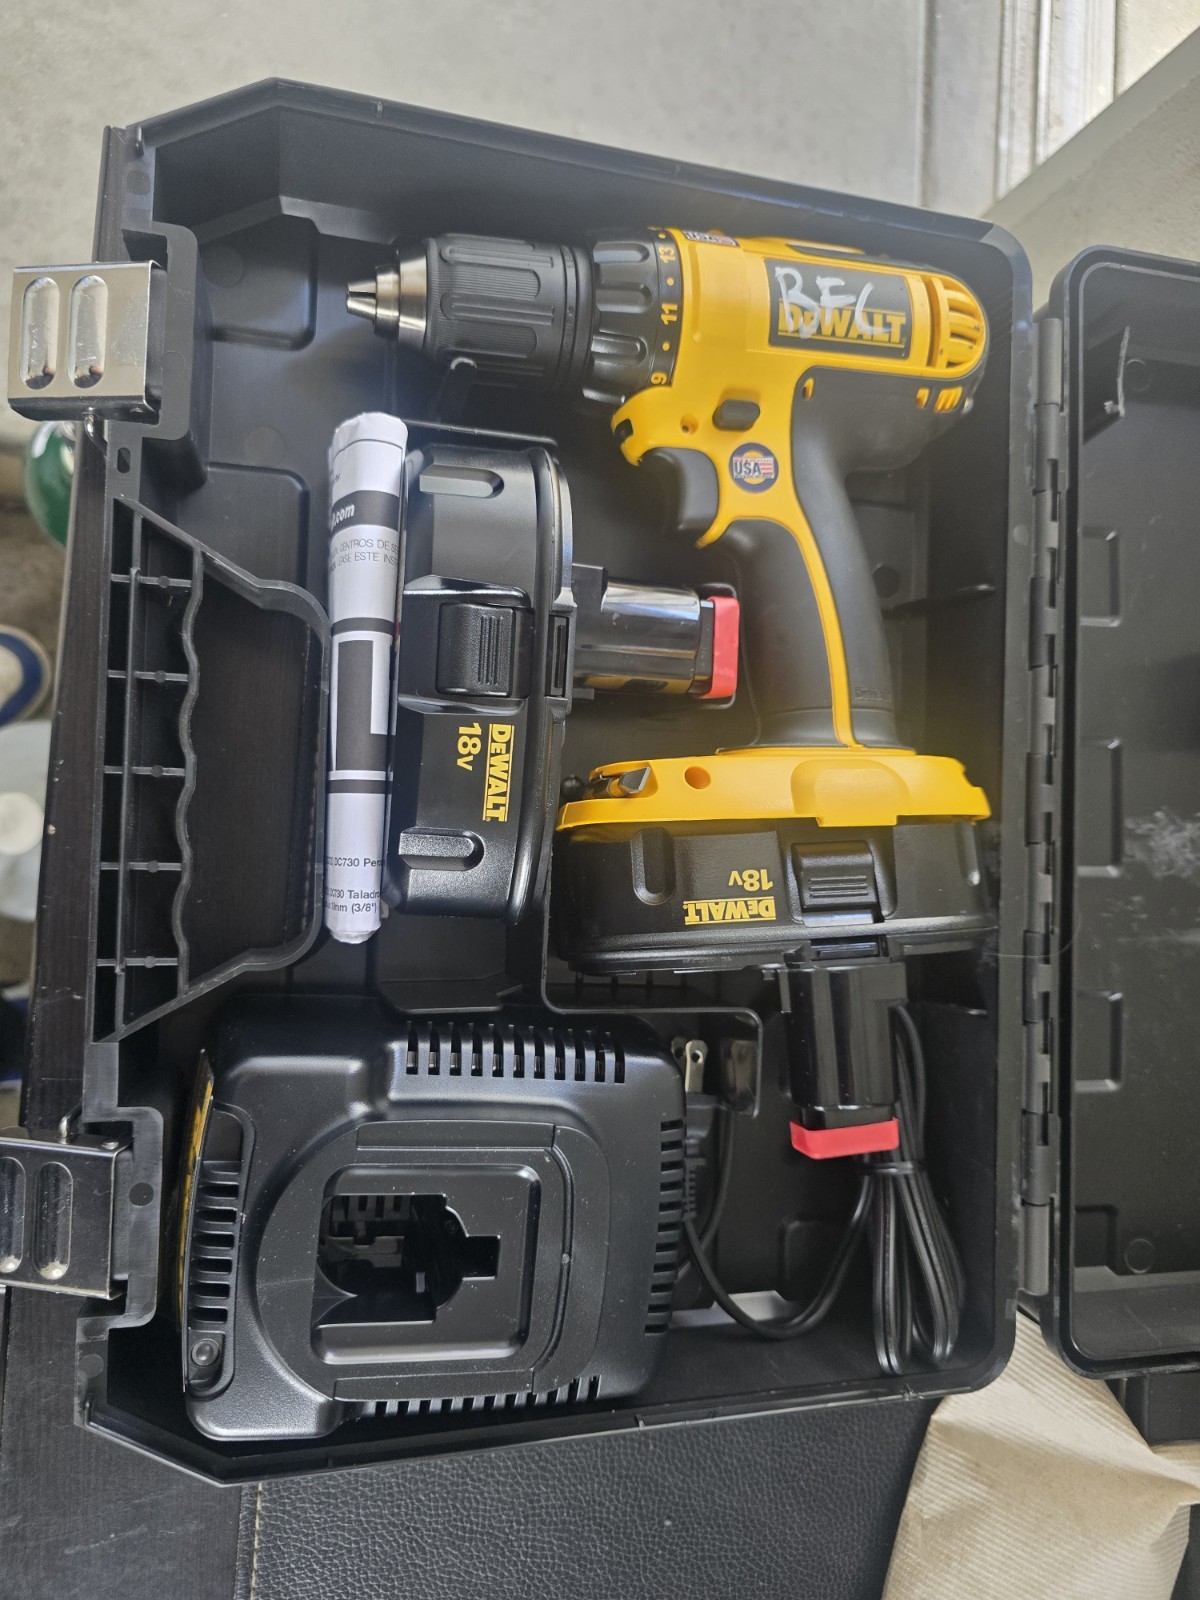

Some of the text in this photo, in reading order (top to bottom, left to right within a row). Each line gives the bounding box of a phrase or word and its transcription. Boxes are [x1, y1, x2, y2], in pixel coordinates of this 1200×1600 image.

[658, 246, 676, 264] 13
[661, 303, 678, 325] 11
[734, 462, 761, 475] USA
[339, 538, 374, 552] CENTROS
[377, 539, 390, 551] DE
[390, 543, 399, 555] SE
[354, 552, 379, 562] ESTE
[483, 723, 514, 822] DEWALT
[683, 897, 776, 924] DEWALT
